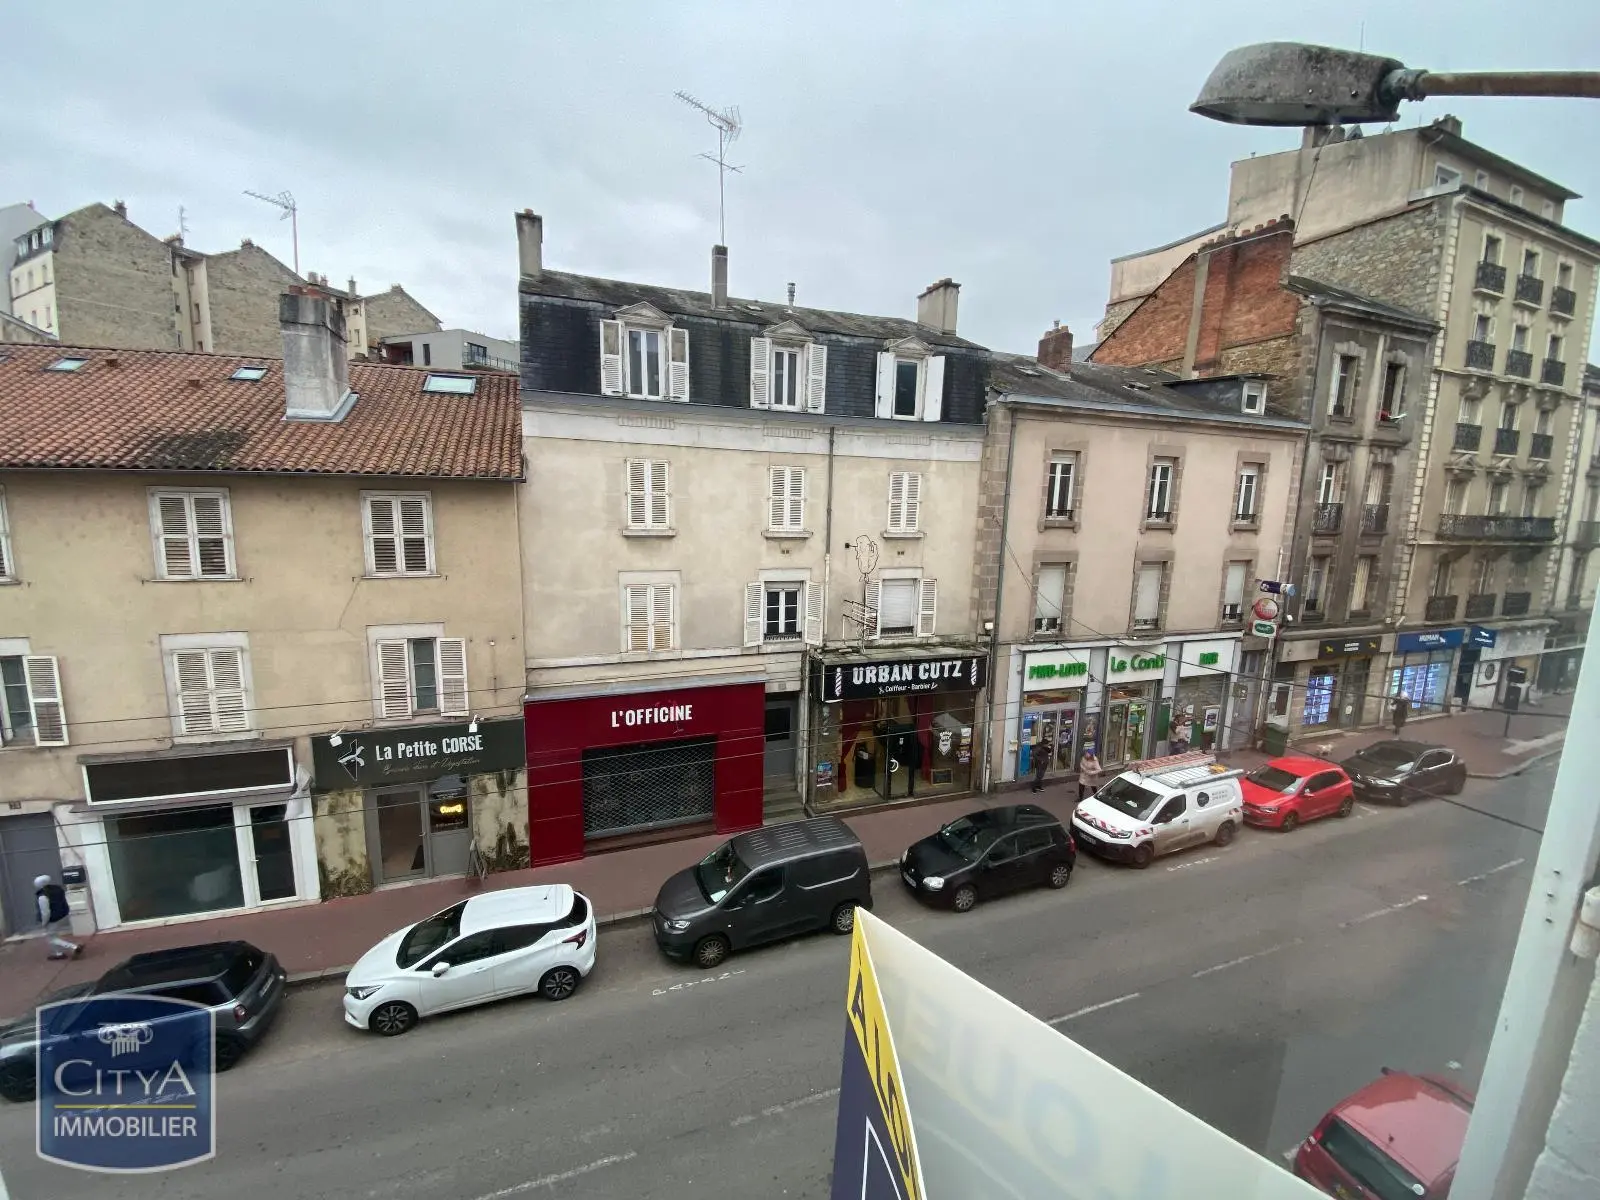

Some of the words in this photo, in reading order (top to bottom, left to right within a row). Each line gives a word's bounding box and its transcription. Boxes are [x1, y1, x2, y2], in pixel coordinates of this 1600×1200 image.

[852, 663, 913, 685] URBAN
[918, 660, 962, 680] CUTZ
[1110, 656, 1128, 673] Le
[1130, 653, 1166, 671] Conti
[610, 703, 694, 729] L'OFFICINE
[375, 744, 393, 762] La
[397, 740, 438, 759] Petite
[441, 734, 484, 754] CORSE
